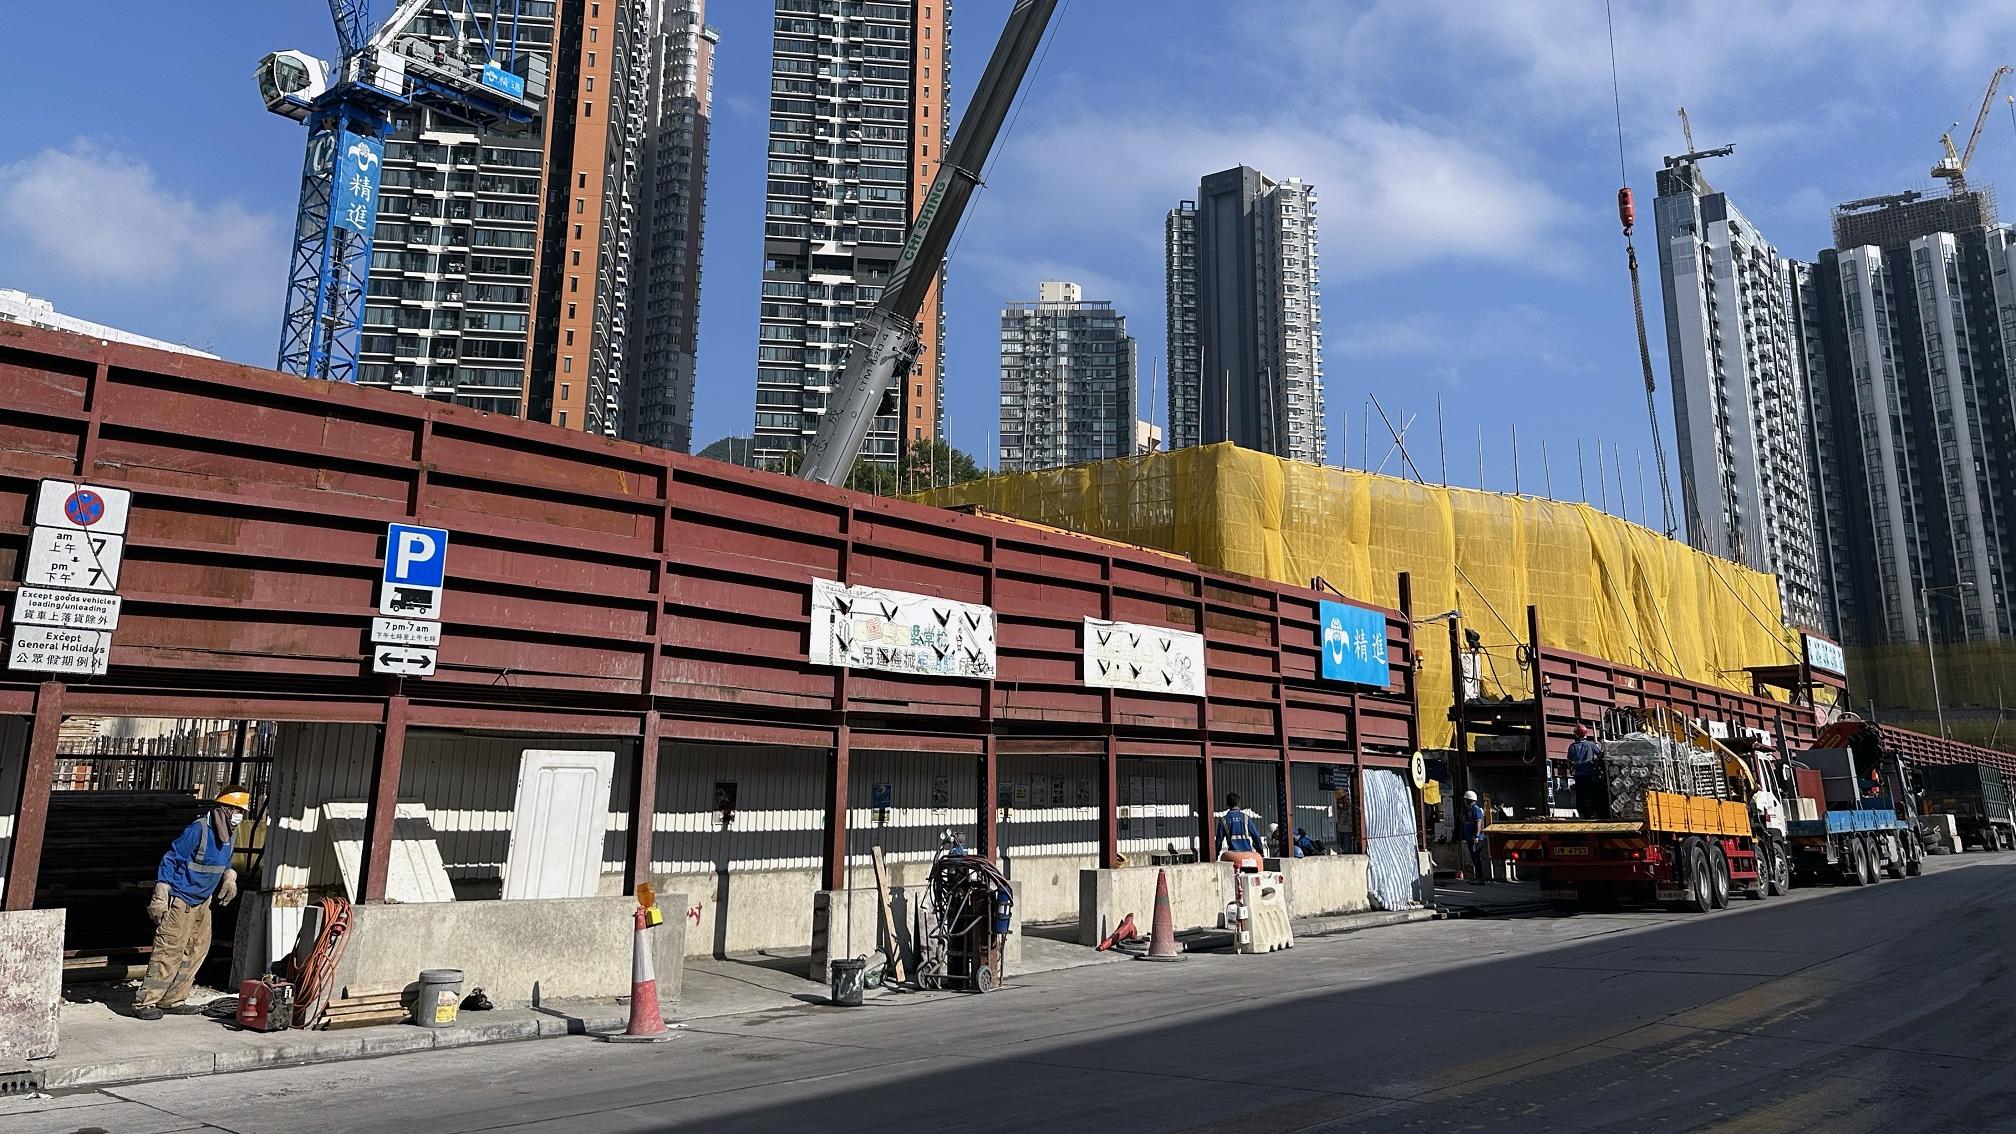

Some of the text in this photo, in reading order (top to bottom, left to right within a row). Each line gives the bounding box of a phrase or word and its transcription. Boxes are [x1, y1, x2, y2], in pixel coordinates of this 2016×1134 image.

[345, 174, 373, 232] 精進
[904, 180, 946, 261] CHI SHING
[49, 541, 76, 554] 上午
[56, 532, 107, 557] am 7
[395, 531, 436, 579] P
[45, 572, 73, 584] 下午
[51, 562, 102, 587] pm 7
[22, 590, 117, 606] Except goods vehicles
[28, 600, 107, 614] loading/unloading
[23, 609, 109, 626] 貨車上落貨除外
[46, 632, 82, 643] Except
[18, 640, 105, 656] General Holidays
[1353, 628, 1387, 665] 精進
[1416, 757, 1422, 774] 8
